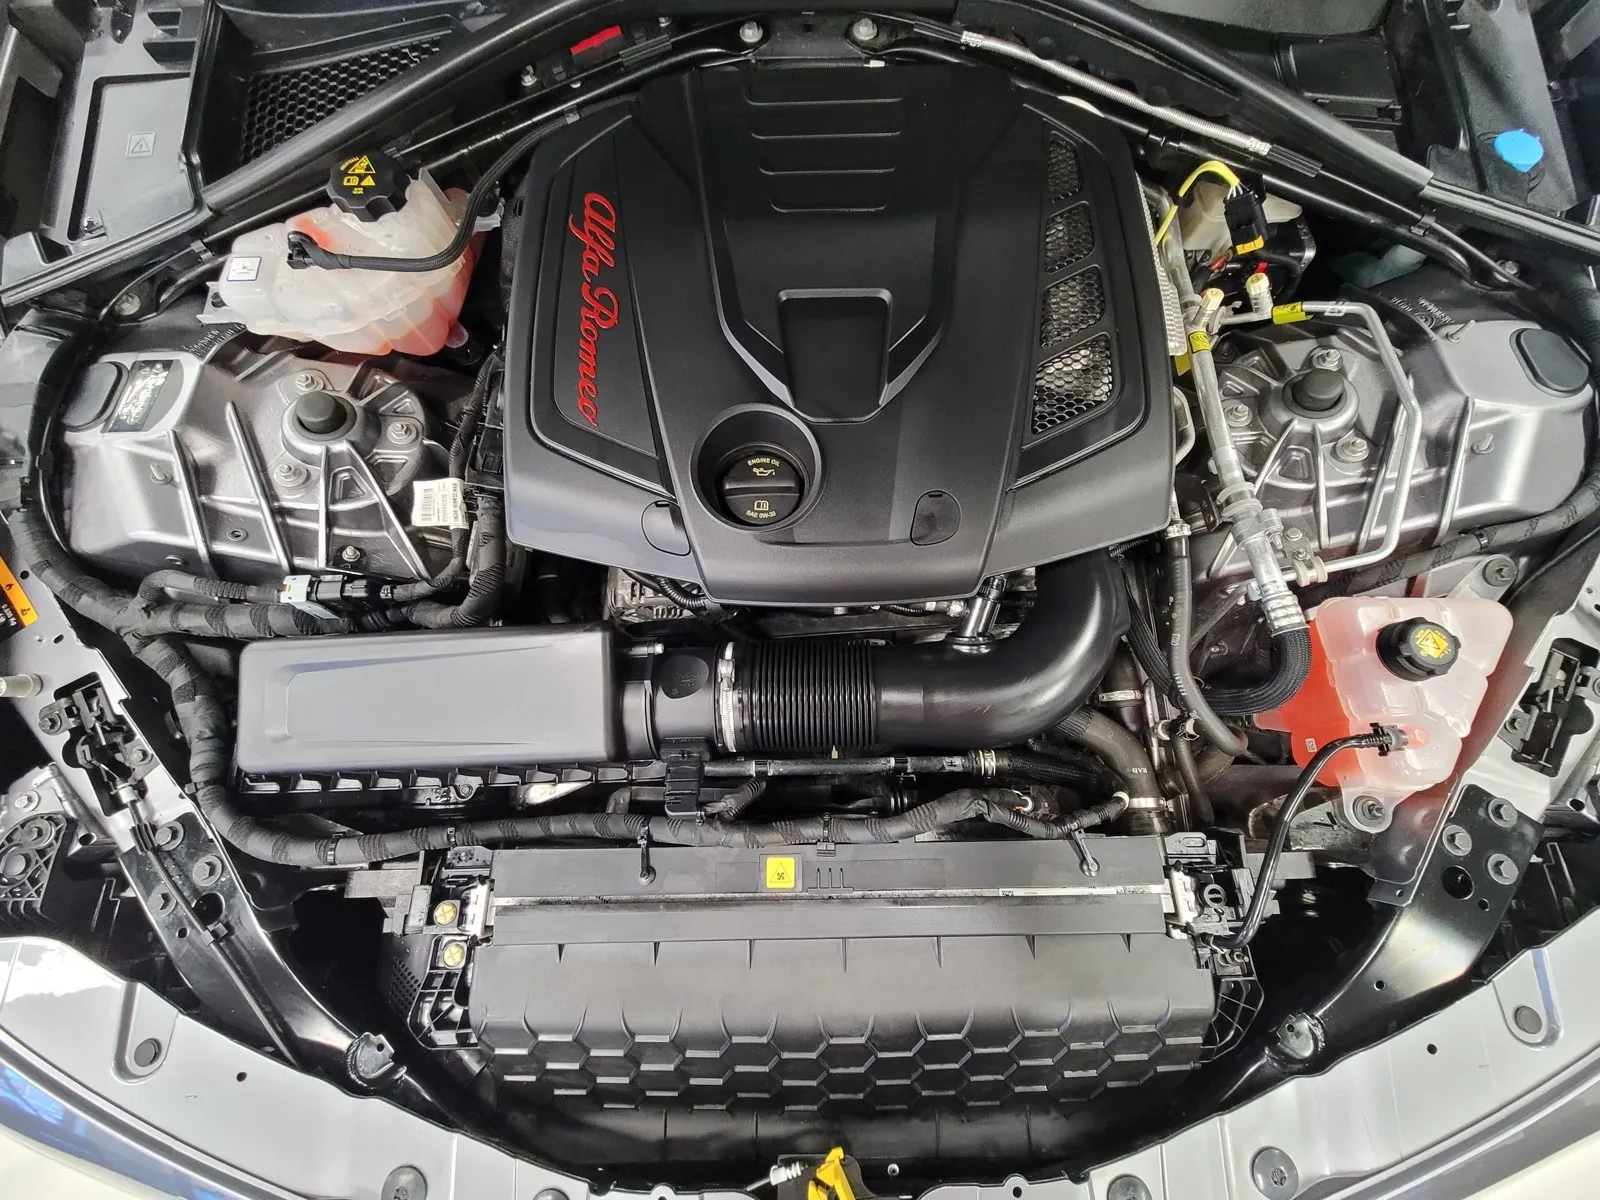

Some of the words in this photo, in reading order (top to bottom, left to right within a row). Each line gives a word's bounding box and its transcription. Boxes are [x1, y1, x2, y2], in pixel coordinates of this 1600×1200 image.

[568, 191, 617, 283] Alfa
[578, 281, 619, 428] Romeo
[747, 457, 771, 466] ENGINE
[771, 459, 780, 467] OIL
[746, 510, 758, 518] SAE
[758, 510, 776, 518] 0W-30
